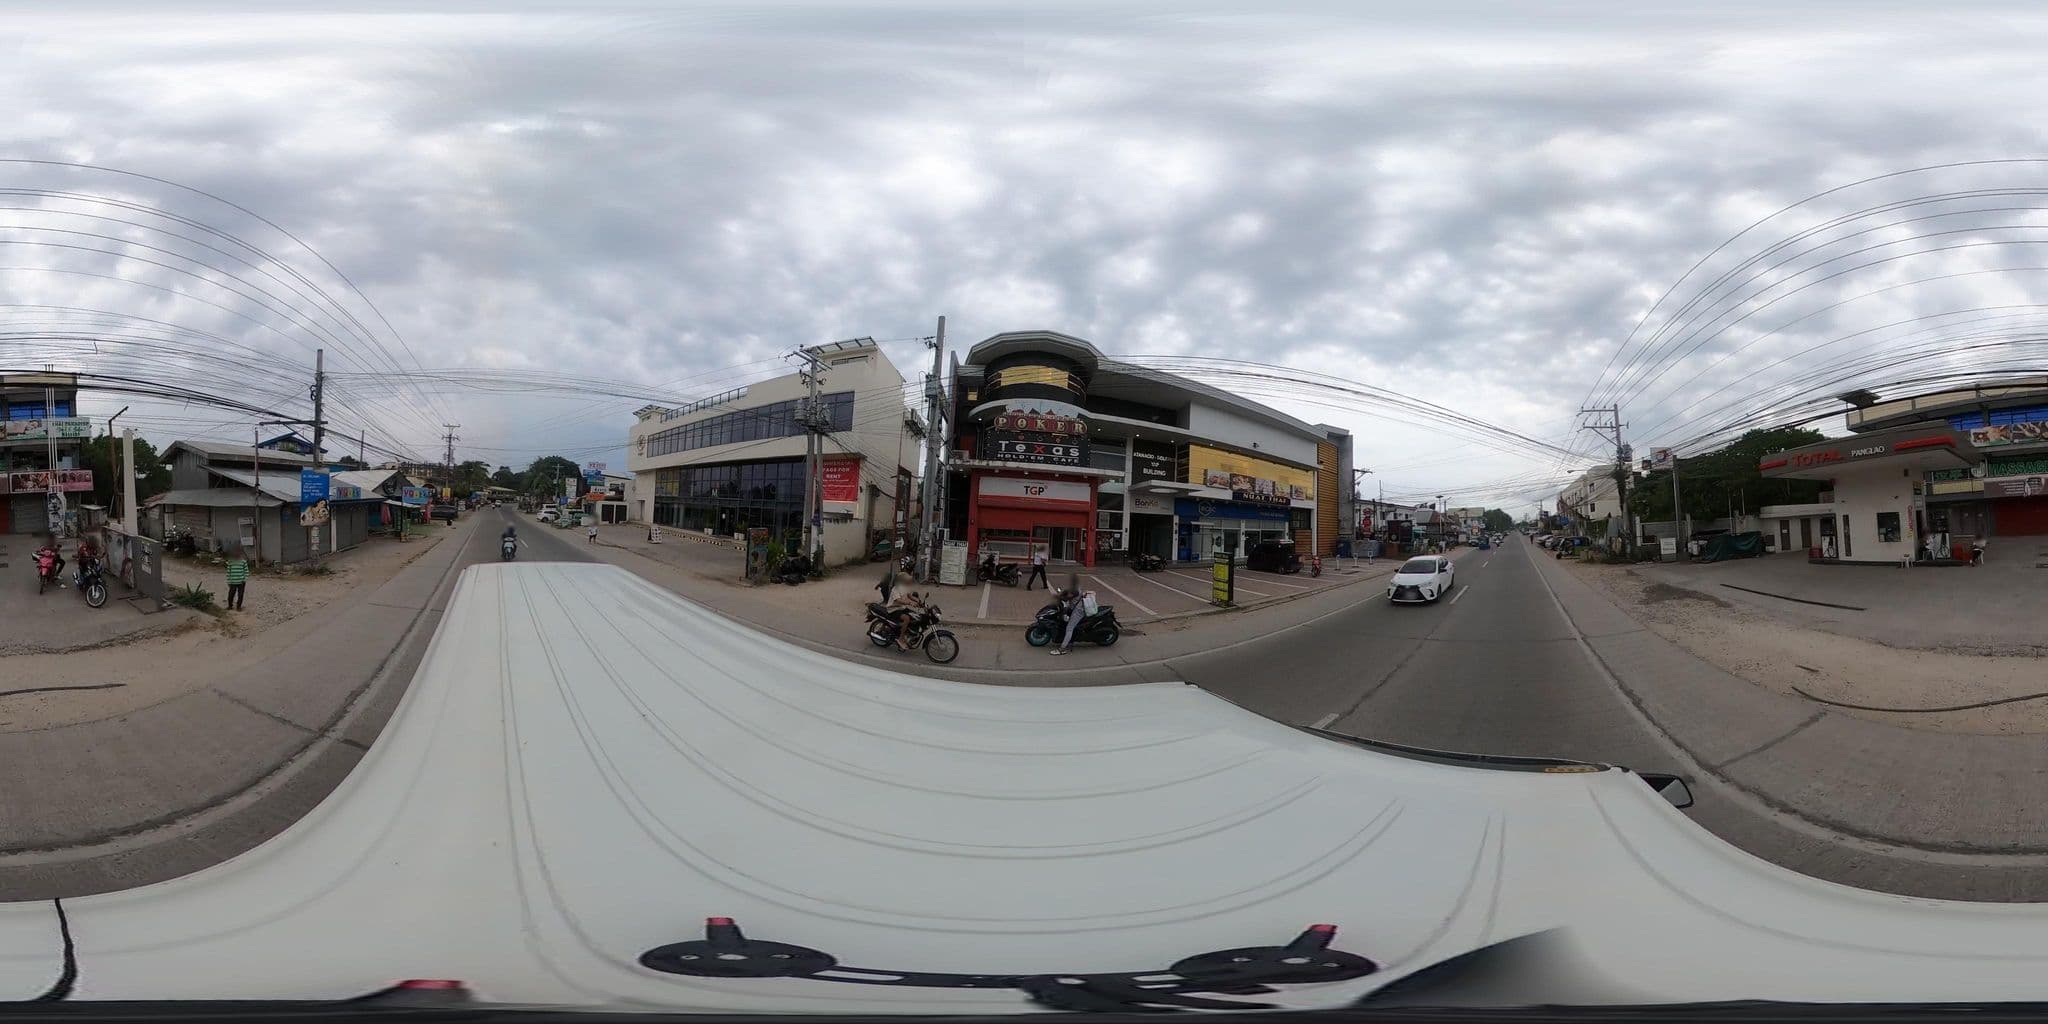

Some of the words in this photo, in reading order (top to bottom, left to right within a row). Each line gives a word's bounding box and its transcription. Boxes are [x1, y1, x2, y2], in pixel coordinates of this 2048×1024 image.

[998, 417, 1084, 433] POKER
[998, 441, 1080, 457] Texas
[1793, 449, 1841, 466] TOTAL
[1850, 445, 1885, 457] PANGLAO
[1143, 467, 1166, 476] BUILDING
[1024, 485, 1045, 496] TGP
[1268, 495, 1287, 504] THAI
